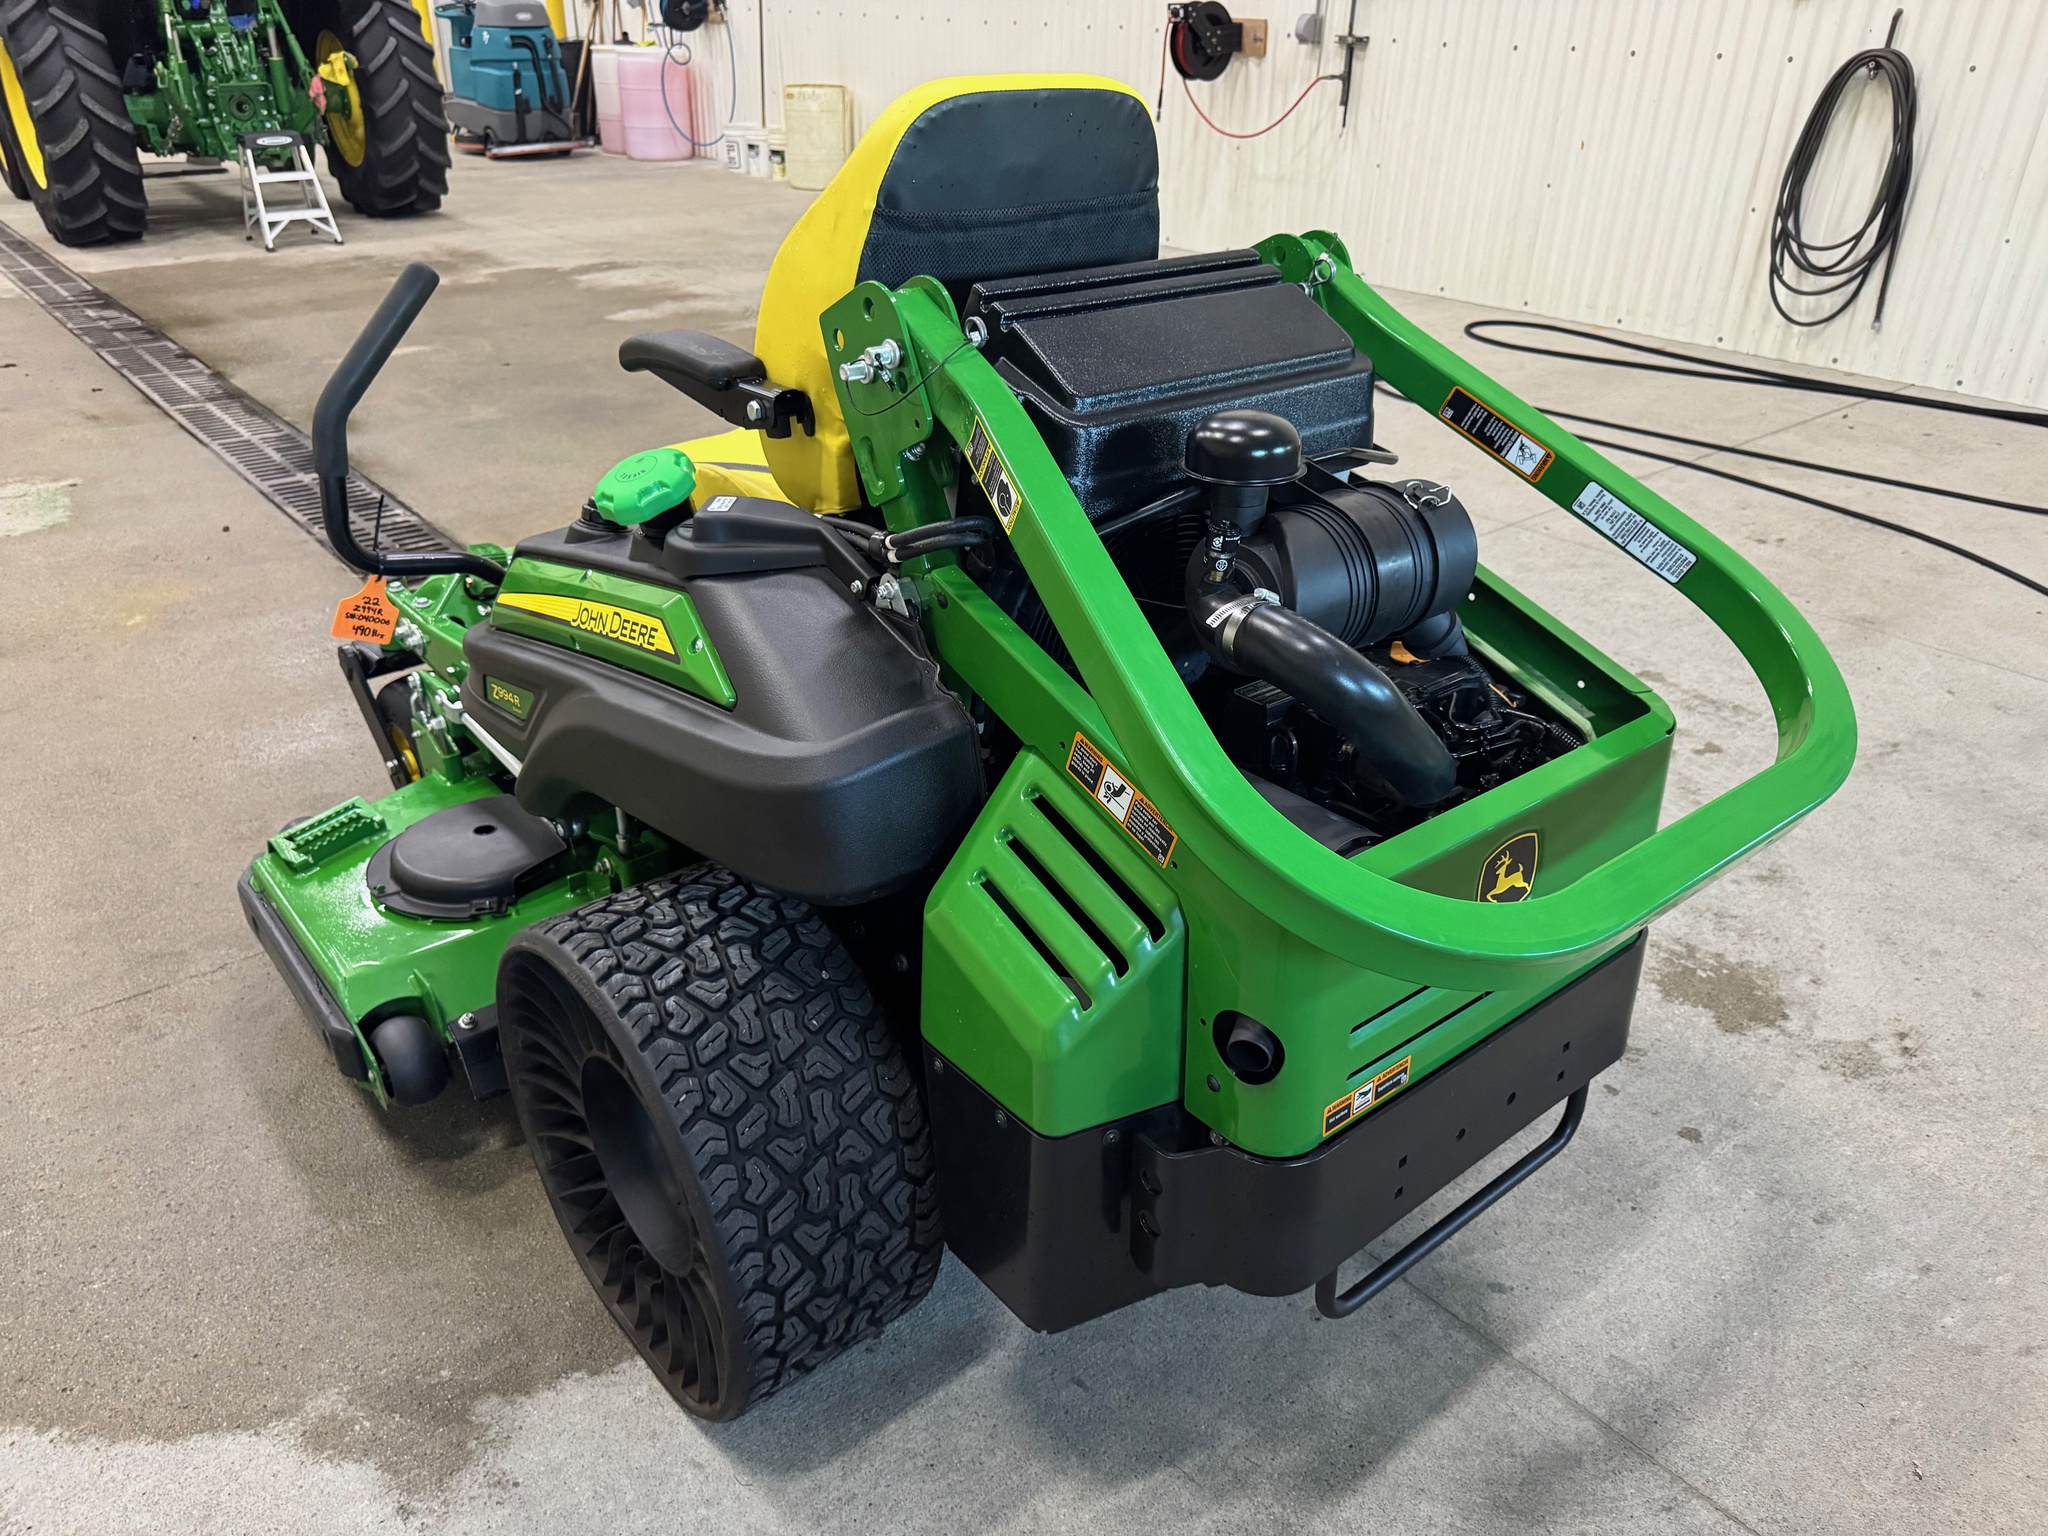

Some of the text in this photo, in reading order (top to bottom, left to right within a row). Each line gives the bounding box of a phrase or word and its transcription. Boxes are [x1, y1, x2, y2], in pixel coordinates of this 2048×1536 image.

[353, 604, 384, 616] Z994R
[352, 625, 371, 637] 490
[572, 602, 659, 648] JOHN DEERE
[491, 683, 521, 707] Z994R
[1084, 743, 1104, 762] WARNING
[1332, 1095, 1352, 1110] WARNING
